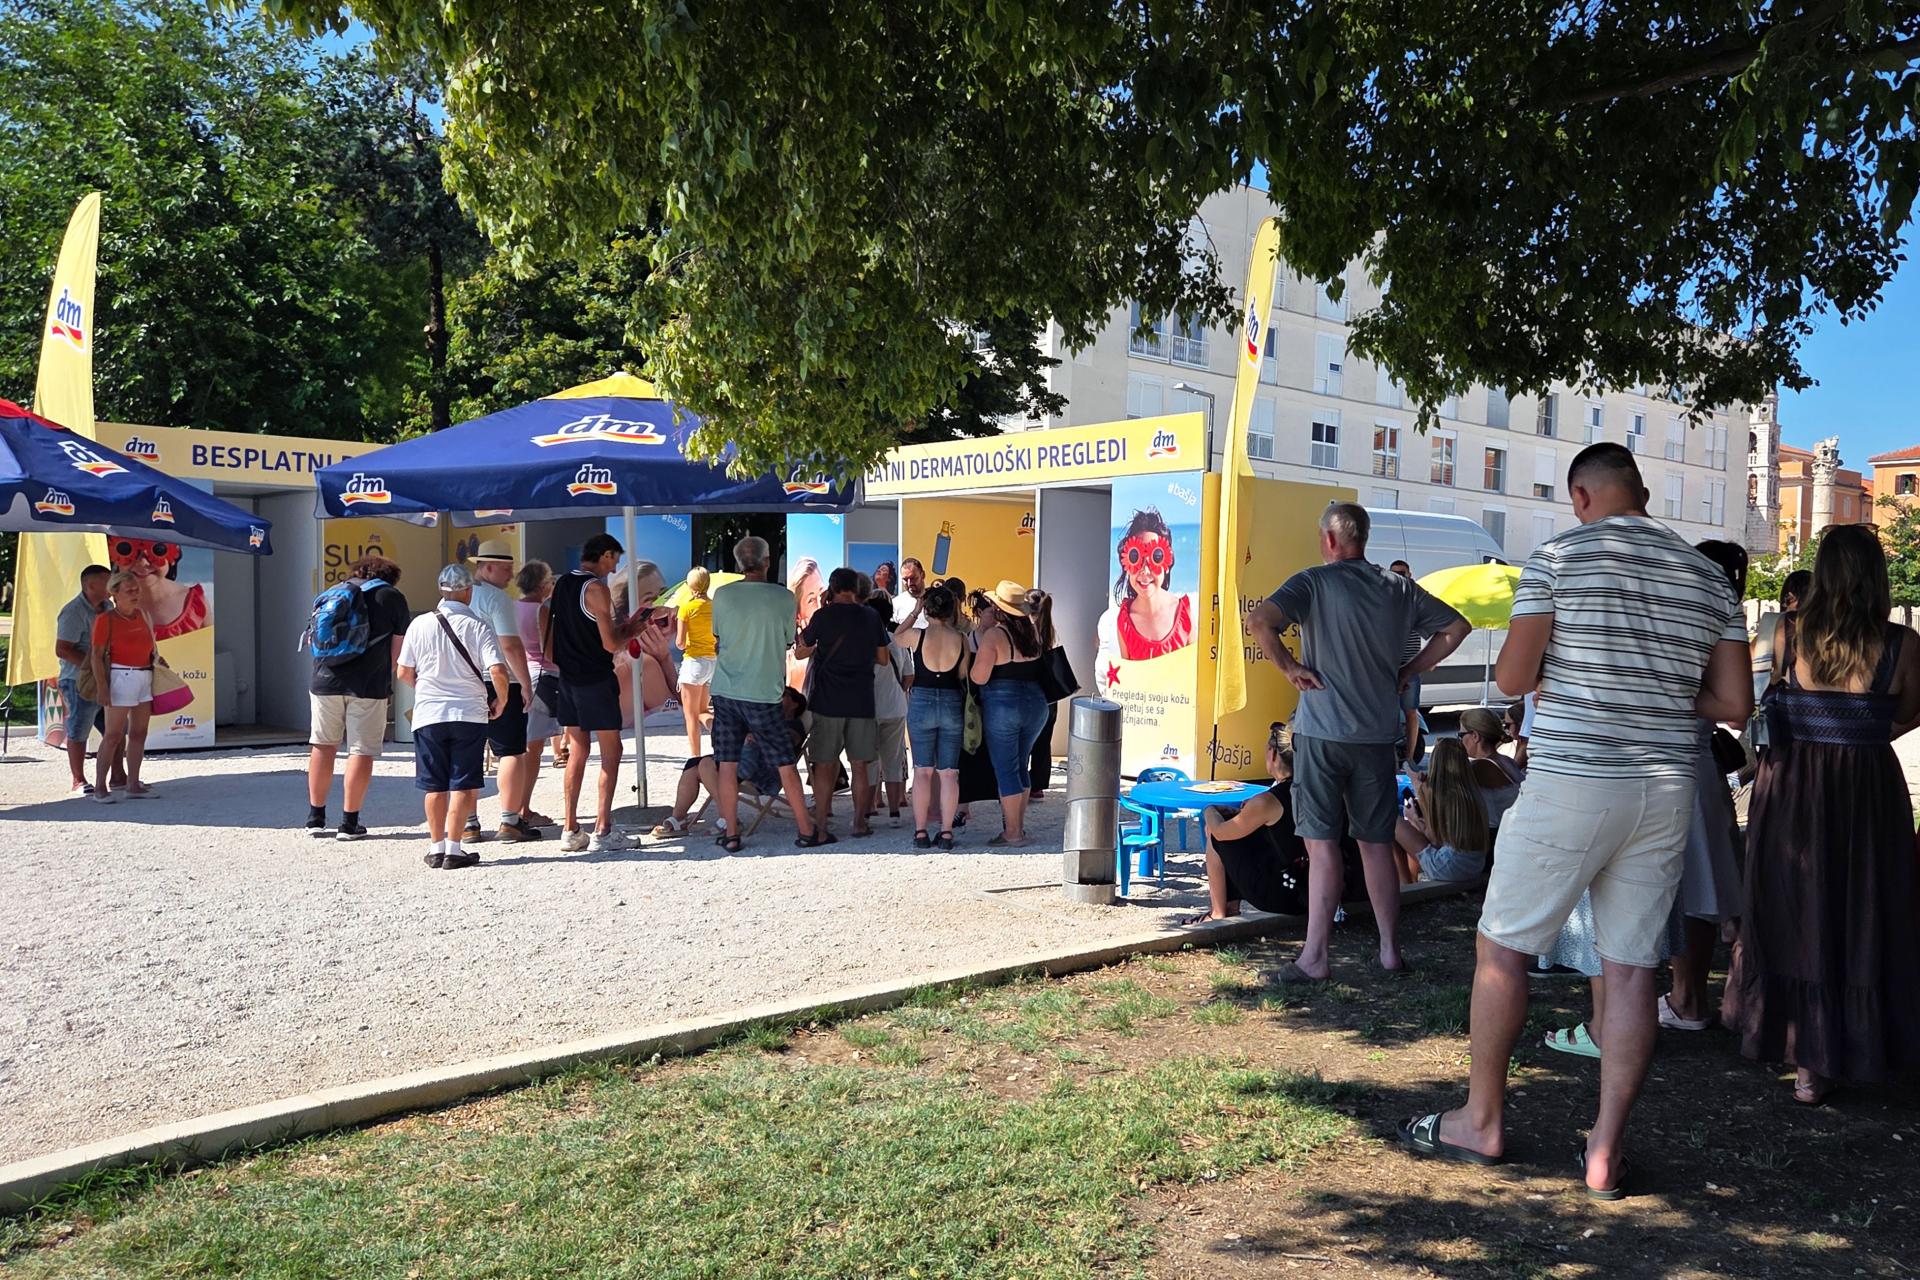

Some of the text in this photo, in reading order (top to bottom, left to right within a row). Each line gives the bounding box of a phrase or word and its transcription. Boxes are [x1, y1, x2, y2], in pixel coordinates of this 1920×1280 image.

[57, 289, 81, 328] dm
[563, 416, 650, 435] dm
[126, 438, 155, 453] dm
[1153, 430, 1175, 448] dm
[192, 444, 332, 472] BESPLATNI
[910, 444, 1031, 480] DERMATOLOŠKI
[1038, 438, 1126, 468] PREGLEDI
[347, 475, 383, 493] dm
[576, 466, 610, 485] dm
[44, 489, 69, 505] dm
[1168, 481, 1197, 506] #bašja
[183, 670, 207, 679] kožu
[1112, 689, 1190, 705] Pregledaj svoju kožu
[1145, 705, 1155, 714] se
[1156, 706, 1165, 715] sa
[175, 715, 194, 725] dm
[1163, 744, 1178, 755] dm
